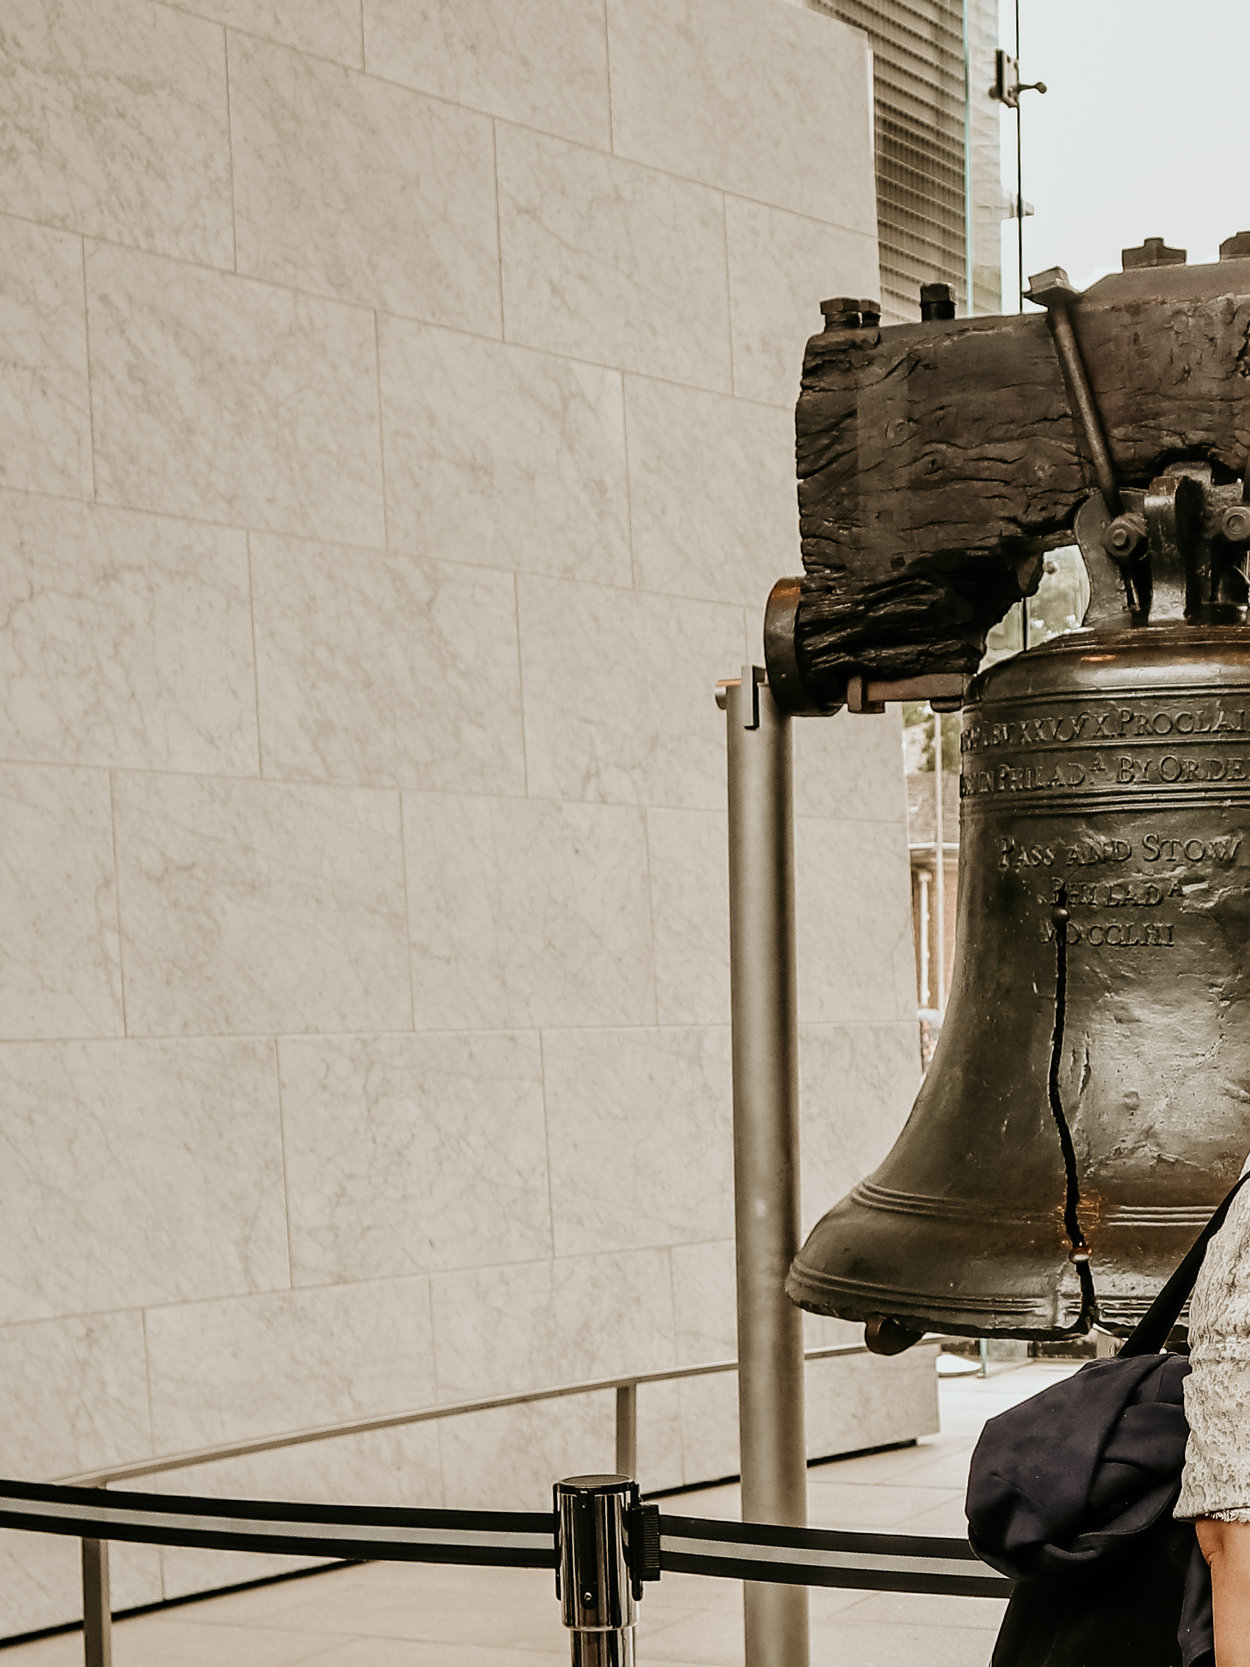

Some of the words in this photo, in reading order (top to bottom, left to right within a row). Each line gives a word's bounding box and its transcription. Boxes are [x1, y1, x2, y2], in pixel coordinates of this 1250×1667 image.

[1115, 755, 1152, 784] BY
[998, 836, 1056, 868] PASS
[1066, 837, 1133, 867] AND
[1142, 833, 1243, 863] STOW
